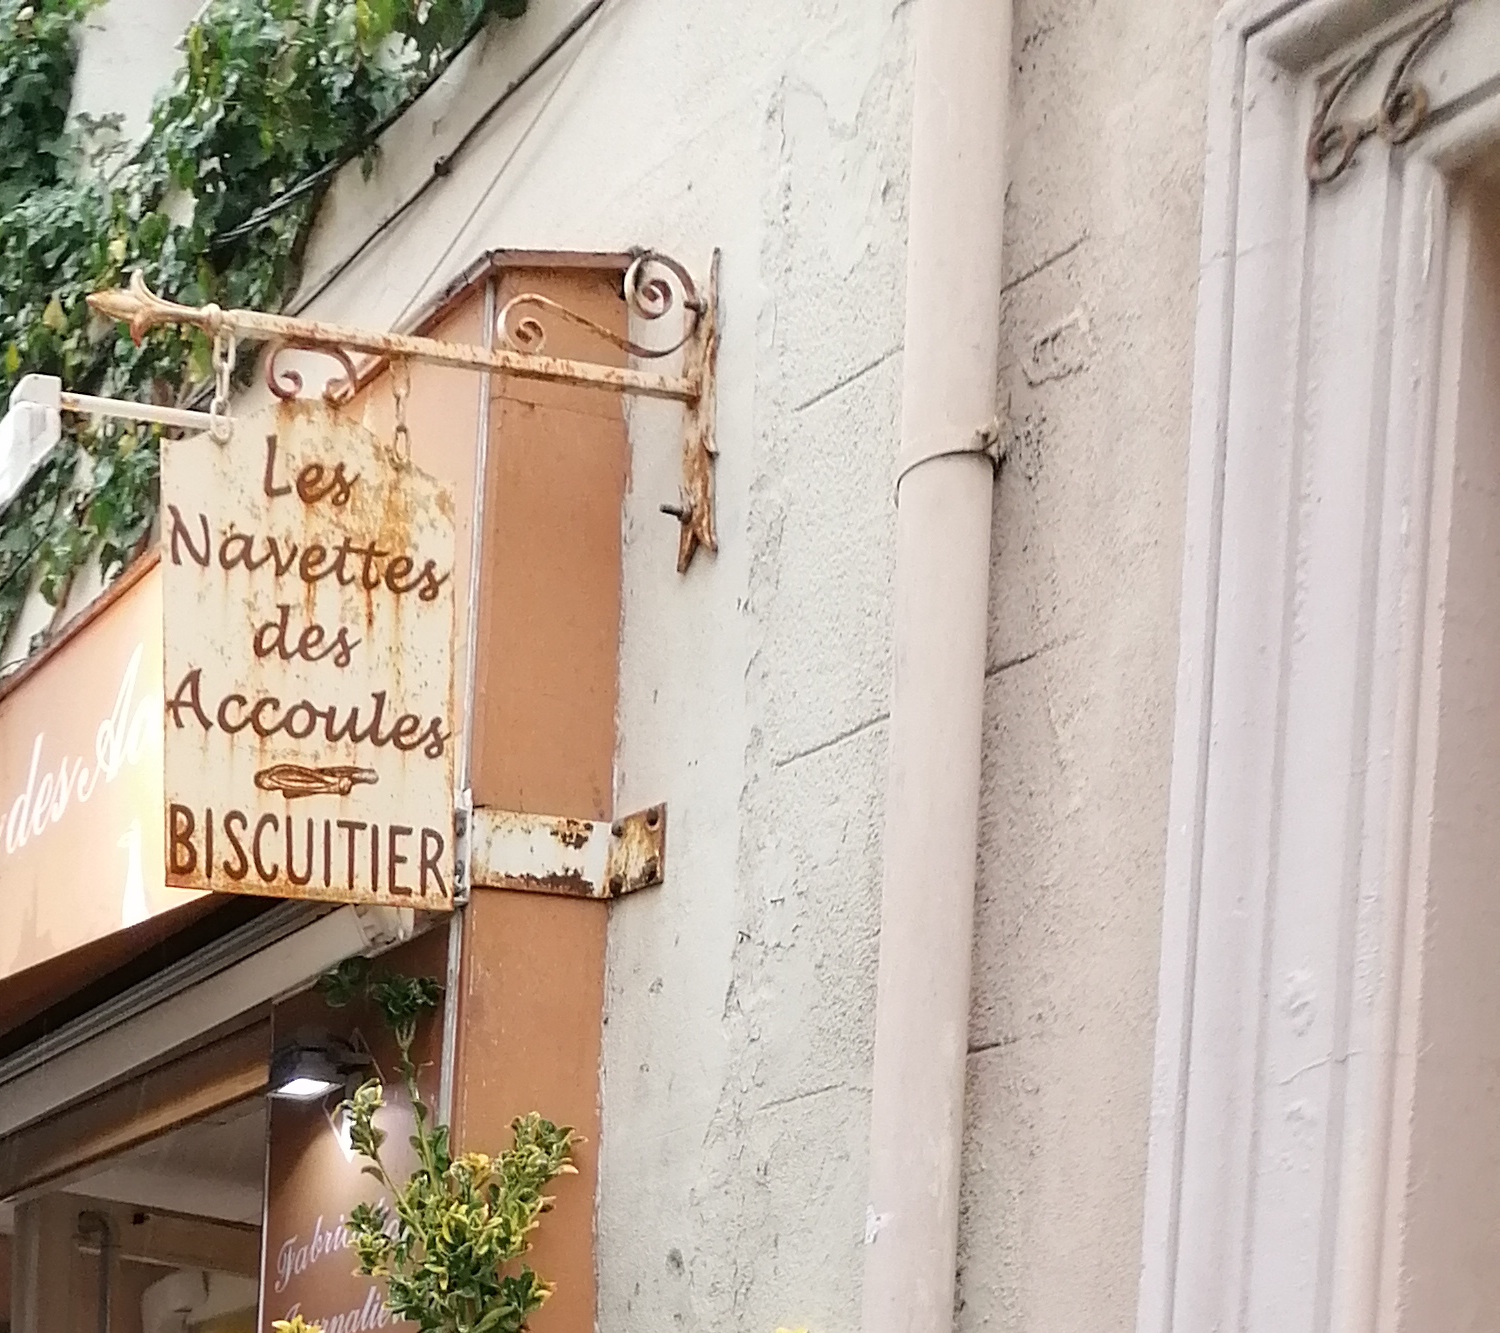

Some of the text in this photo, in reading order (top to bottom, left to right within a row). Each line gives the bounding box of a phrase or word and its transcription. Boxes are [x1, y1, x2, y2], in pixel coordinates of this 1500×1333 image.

[263, 434, 360, 505] Les
[167, 504, 450, 601] Navettes
[252, 604, 362, 668] des
[165, 667, 452, 760] Accoules
[5, 731, 81, 855] des
[167, 802, 449, 898] BISCUITIER
